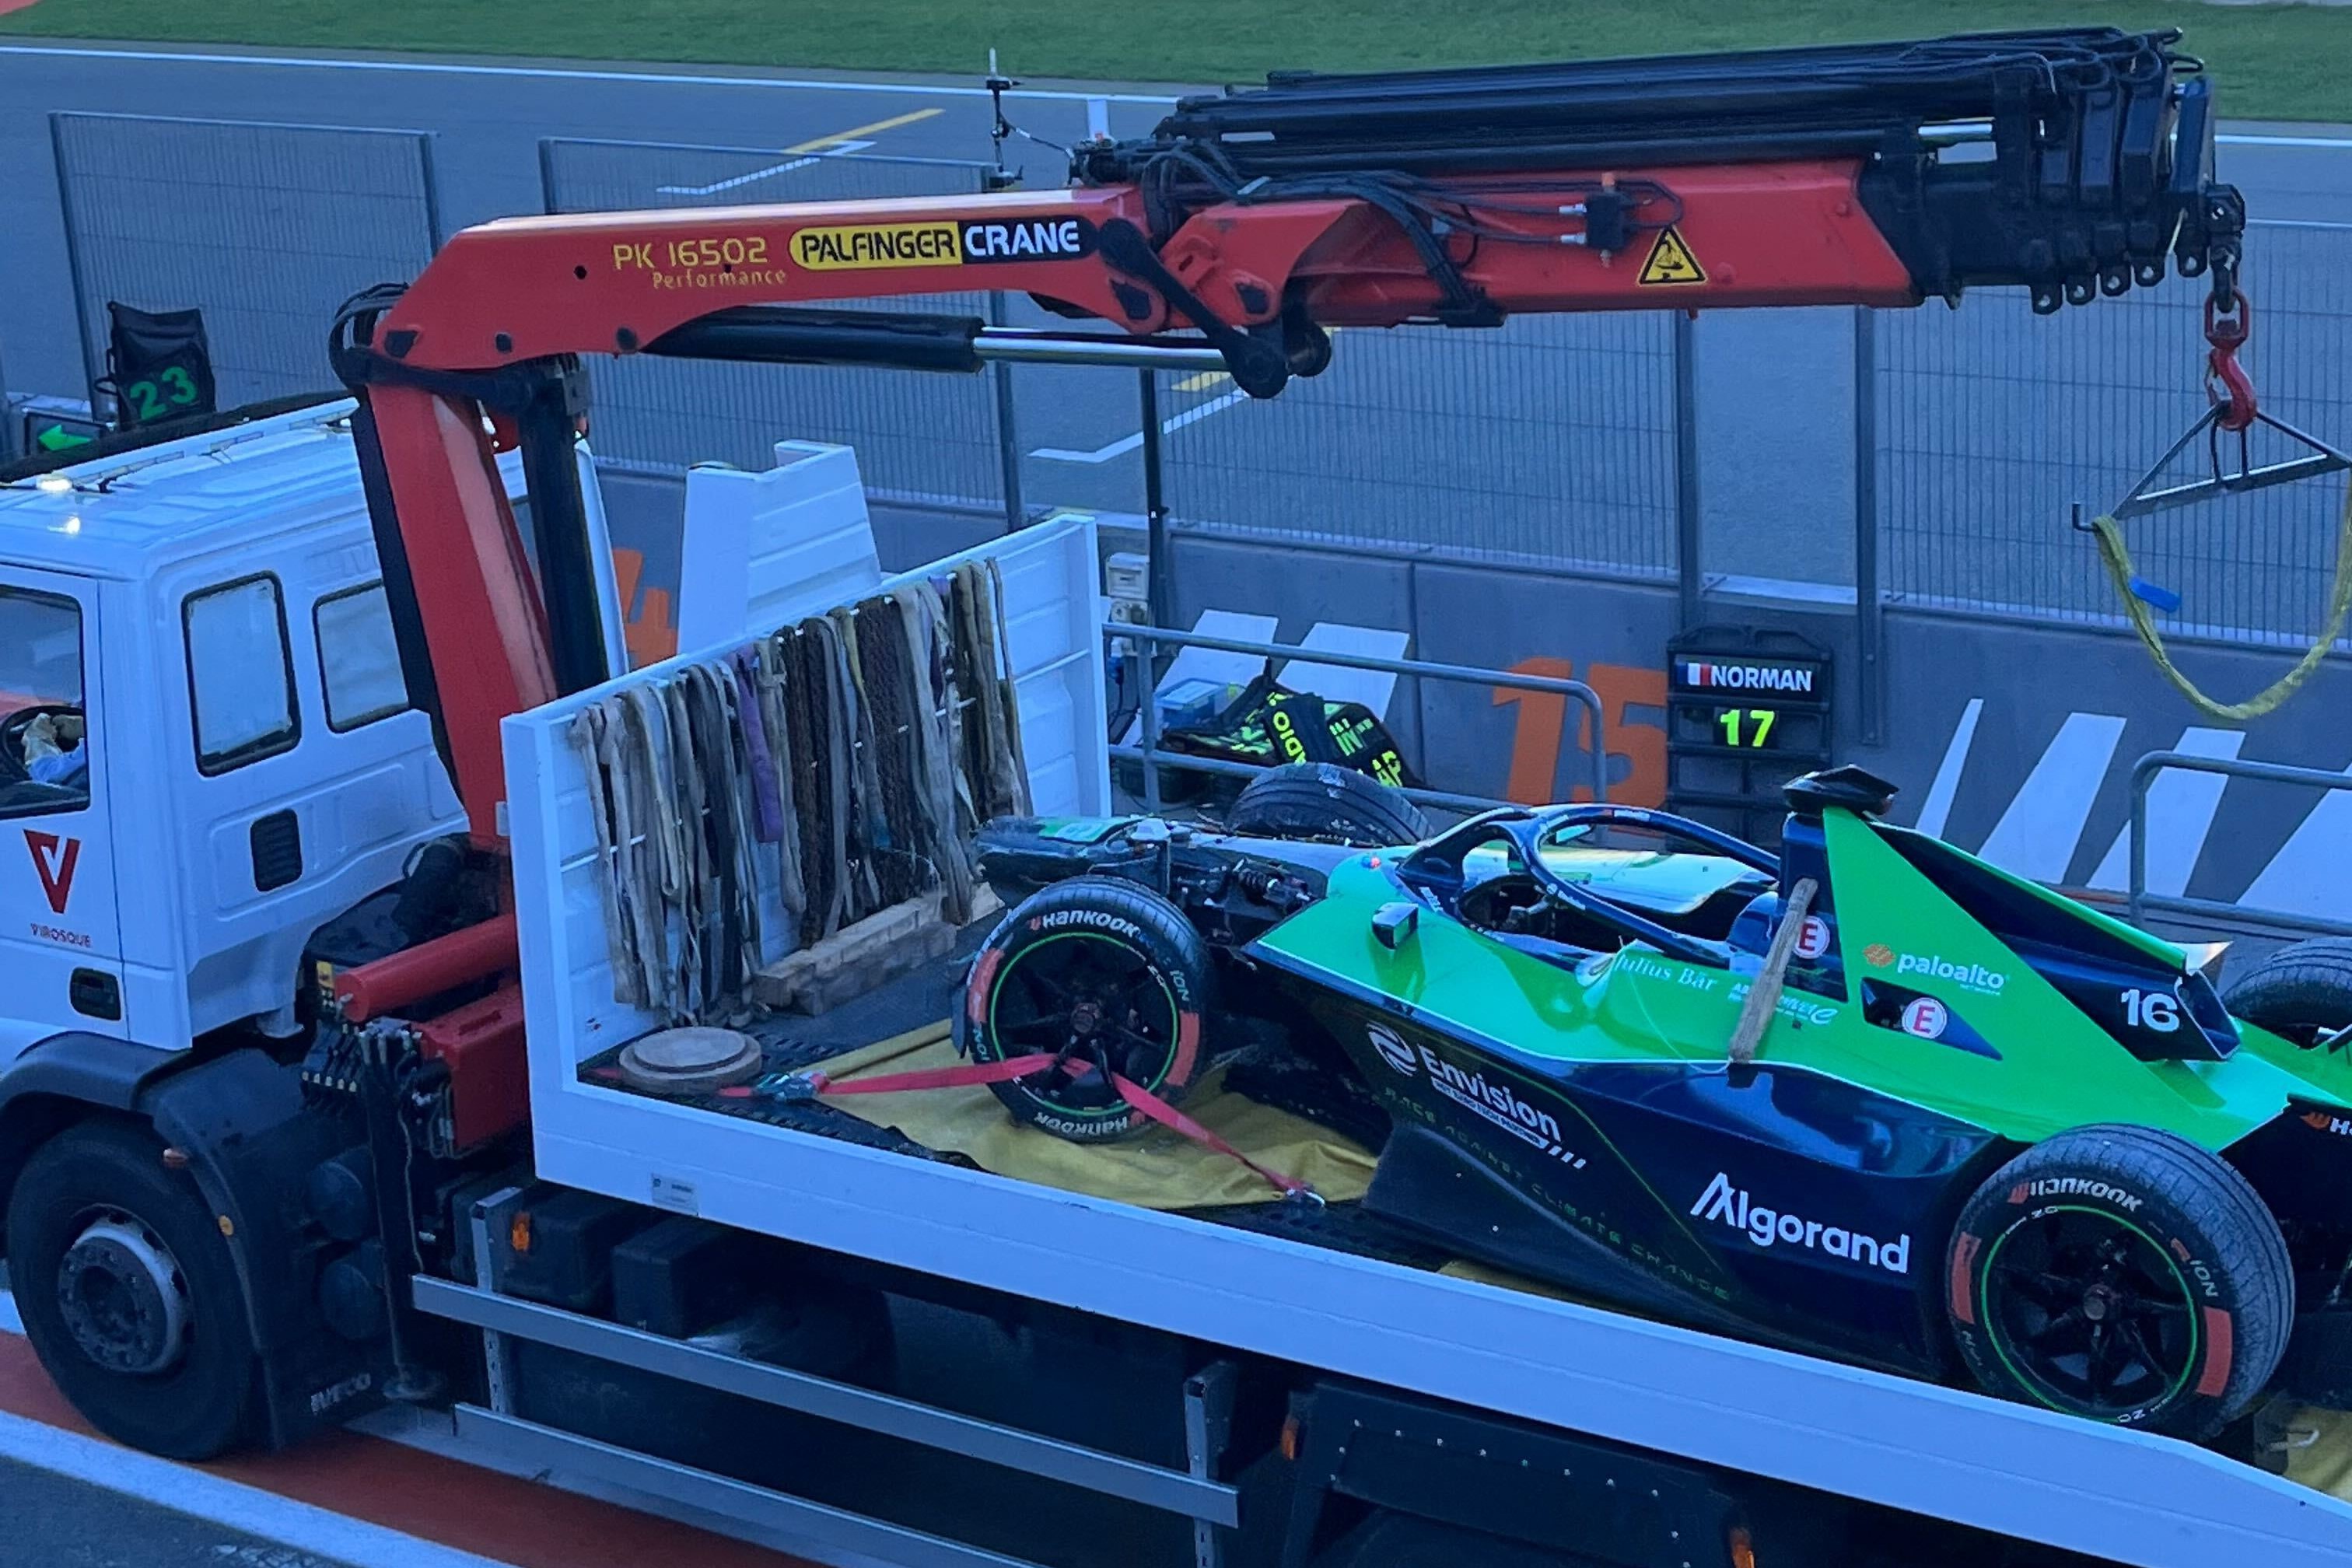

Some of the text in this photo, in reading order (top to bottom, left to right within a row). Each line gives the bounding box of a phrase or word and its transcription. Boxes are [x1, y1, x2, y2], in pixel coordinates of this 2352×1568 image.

[613, 236, 768, 270] PK 16502
[800, 221, 1081, 263] PALFINGER CRANE
[652, 269, 787, 289] Performance
[130, 366, 199, 421] 23
[1710, 664, 1812, 693] NORMAN
[1493, 656, 1669, 809] 15
[1719, 709, 1776, 747] 17
[1800, 921, 1819, 952] E
[1897, 950, 2006, 990] paloalto
[1913, 1006, 1936, 1035] E
[2121, 988, 2180, 1033] 16
[1416, 1044, 1562, 1142] Envision
[1689, 1171, 1911, 1275] Algorand
